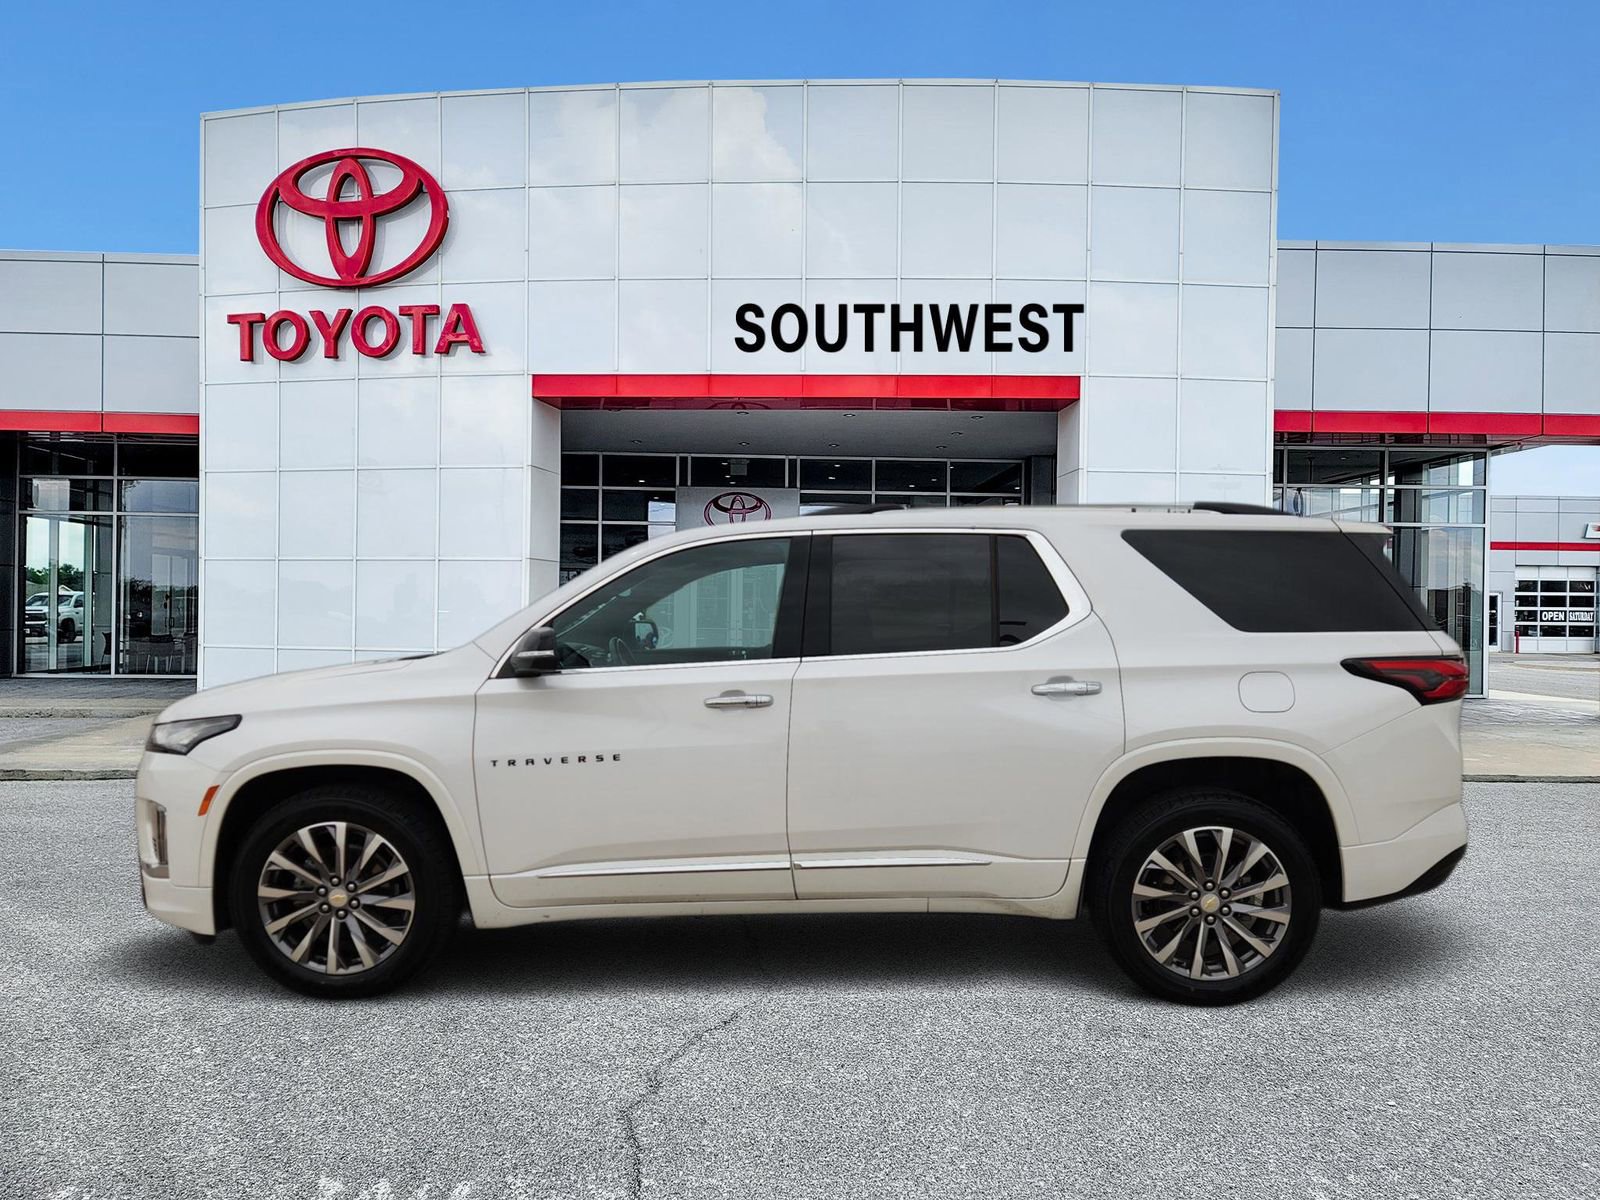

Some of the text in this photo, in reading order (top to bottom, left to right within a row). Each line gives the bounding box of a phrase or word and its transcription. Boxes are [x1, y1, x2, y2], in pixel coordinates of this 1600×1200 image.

[227, 303, 486, 361] TOYOTA
[734, 303, 1085, 353] SOUTHWEST
[1541, 611, 1565, 621] OPEN
[490, 753, 621, 768] TRAVERSE
